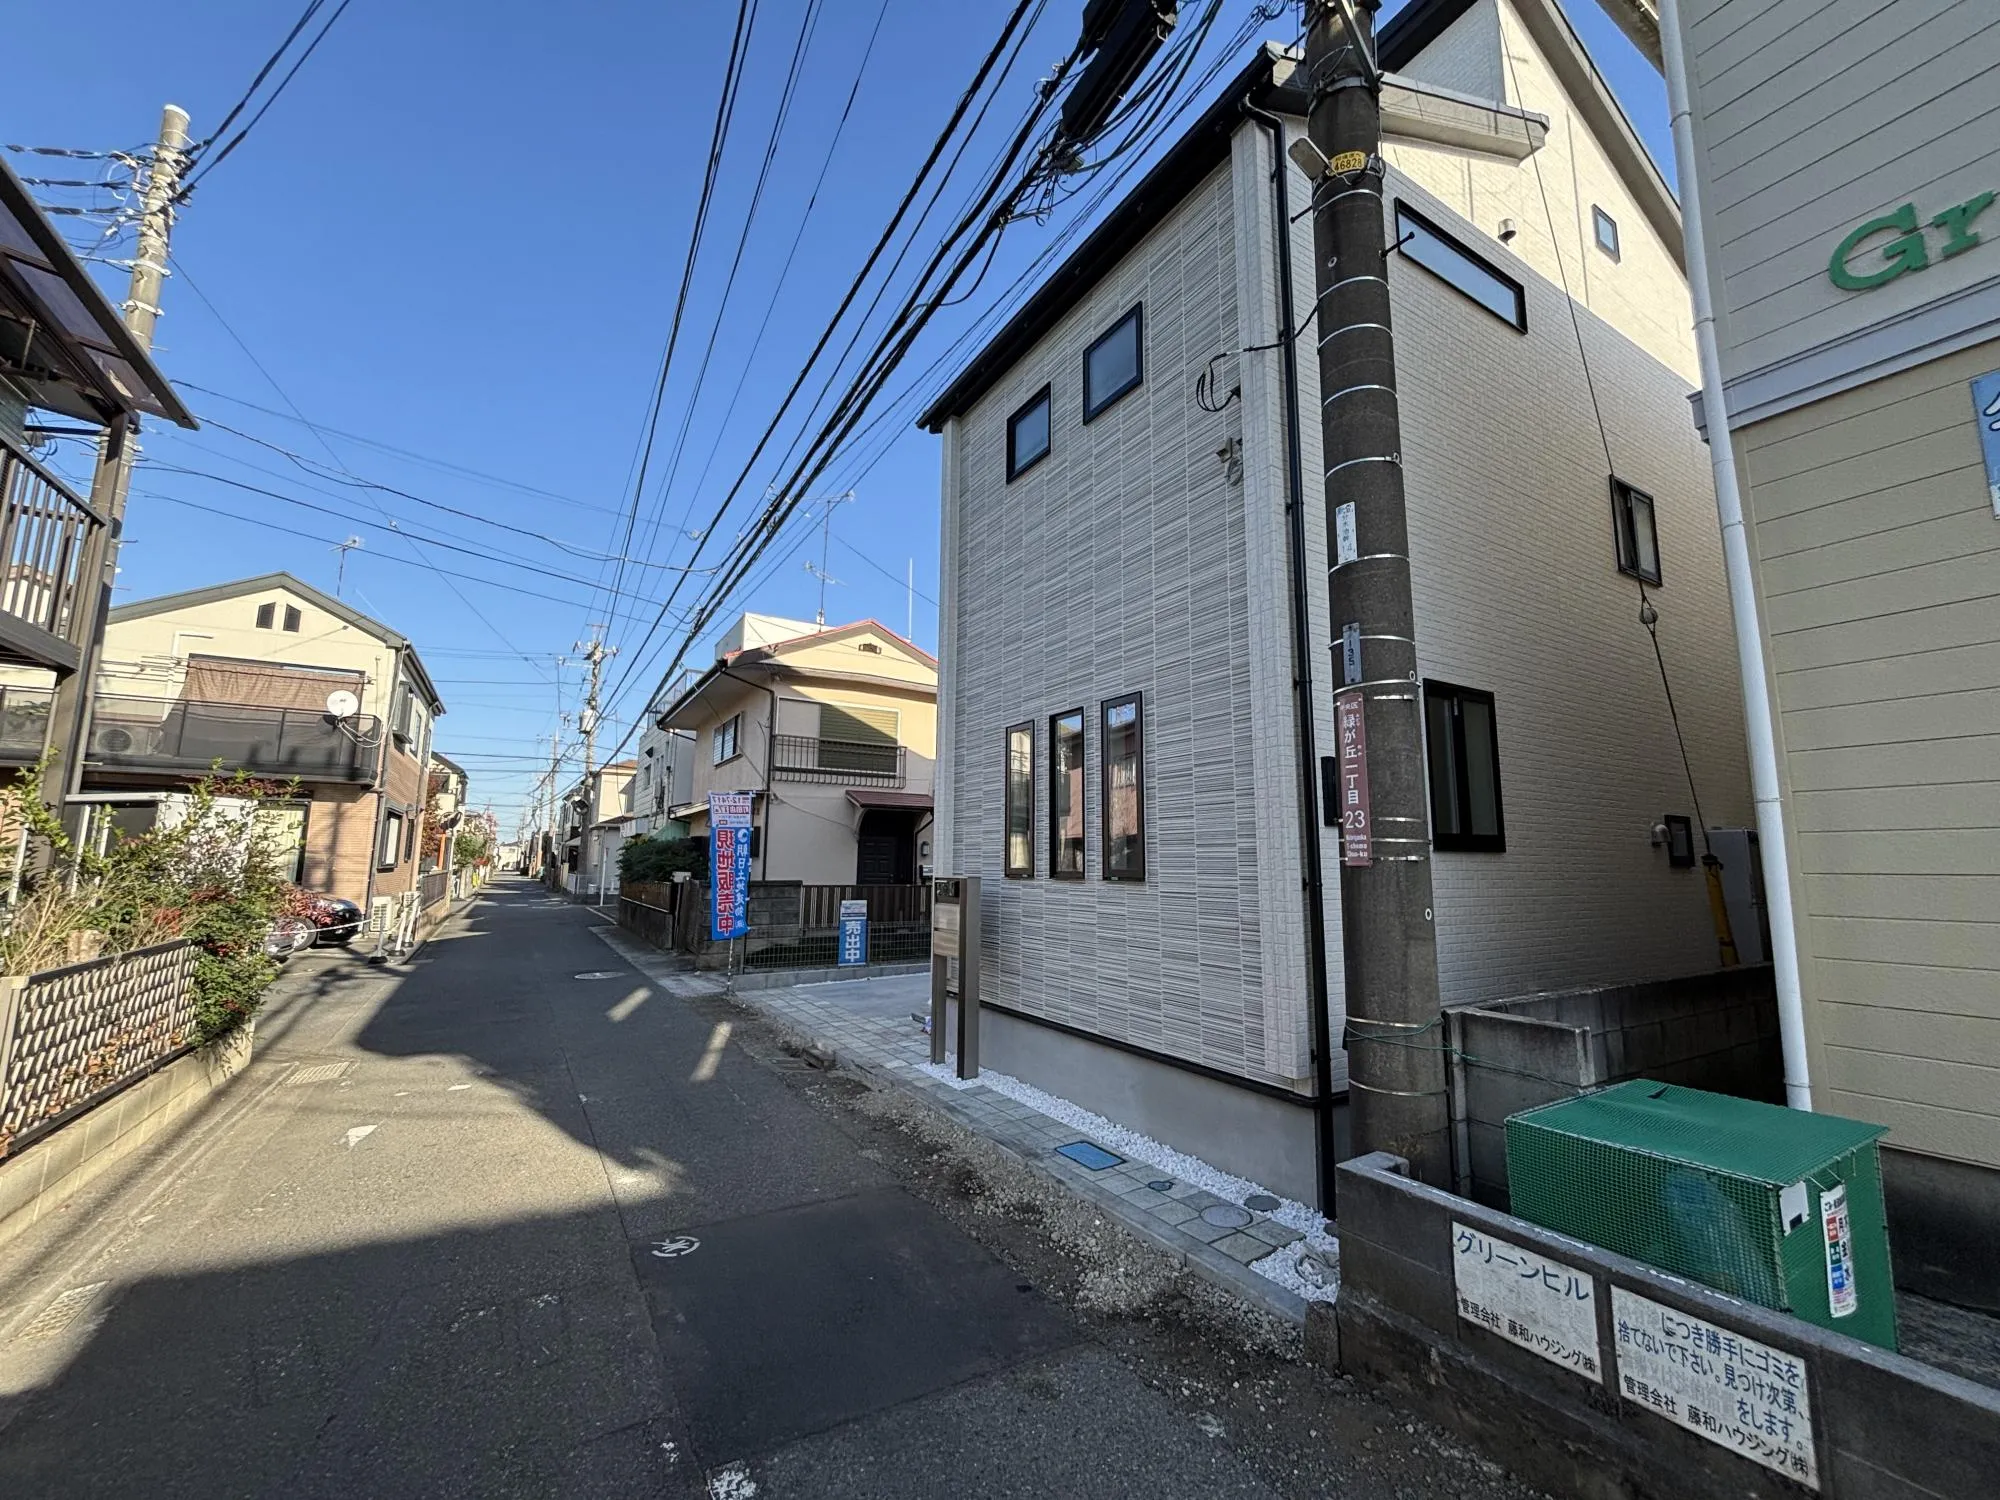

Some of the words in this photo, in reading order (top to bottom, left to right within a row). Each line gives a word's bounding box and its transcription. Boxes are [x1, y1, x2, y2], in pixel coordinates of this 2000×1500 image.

[1334, 158, 1362, 171] 46828
[1828, 189, 1999, 291] Gr
[1344, 810, 1365, 829] 23
[845, 920, 861, 962] 売出中
[1457, 1230, 1590, 1301] グリーンヒル
[1459, 1296, 1501, 1329] 管理会社
[1661, 1312, 1799, 1390] につき勝手にゴミを
[1623, 1375, 1678, 1417] 管理会社
